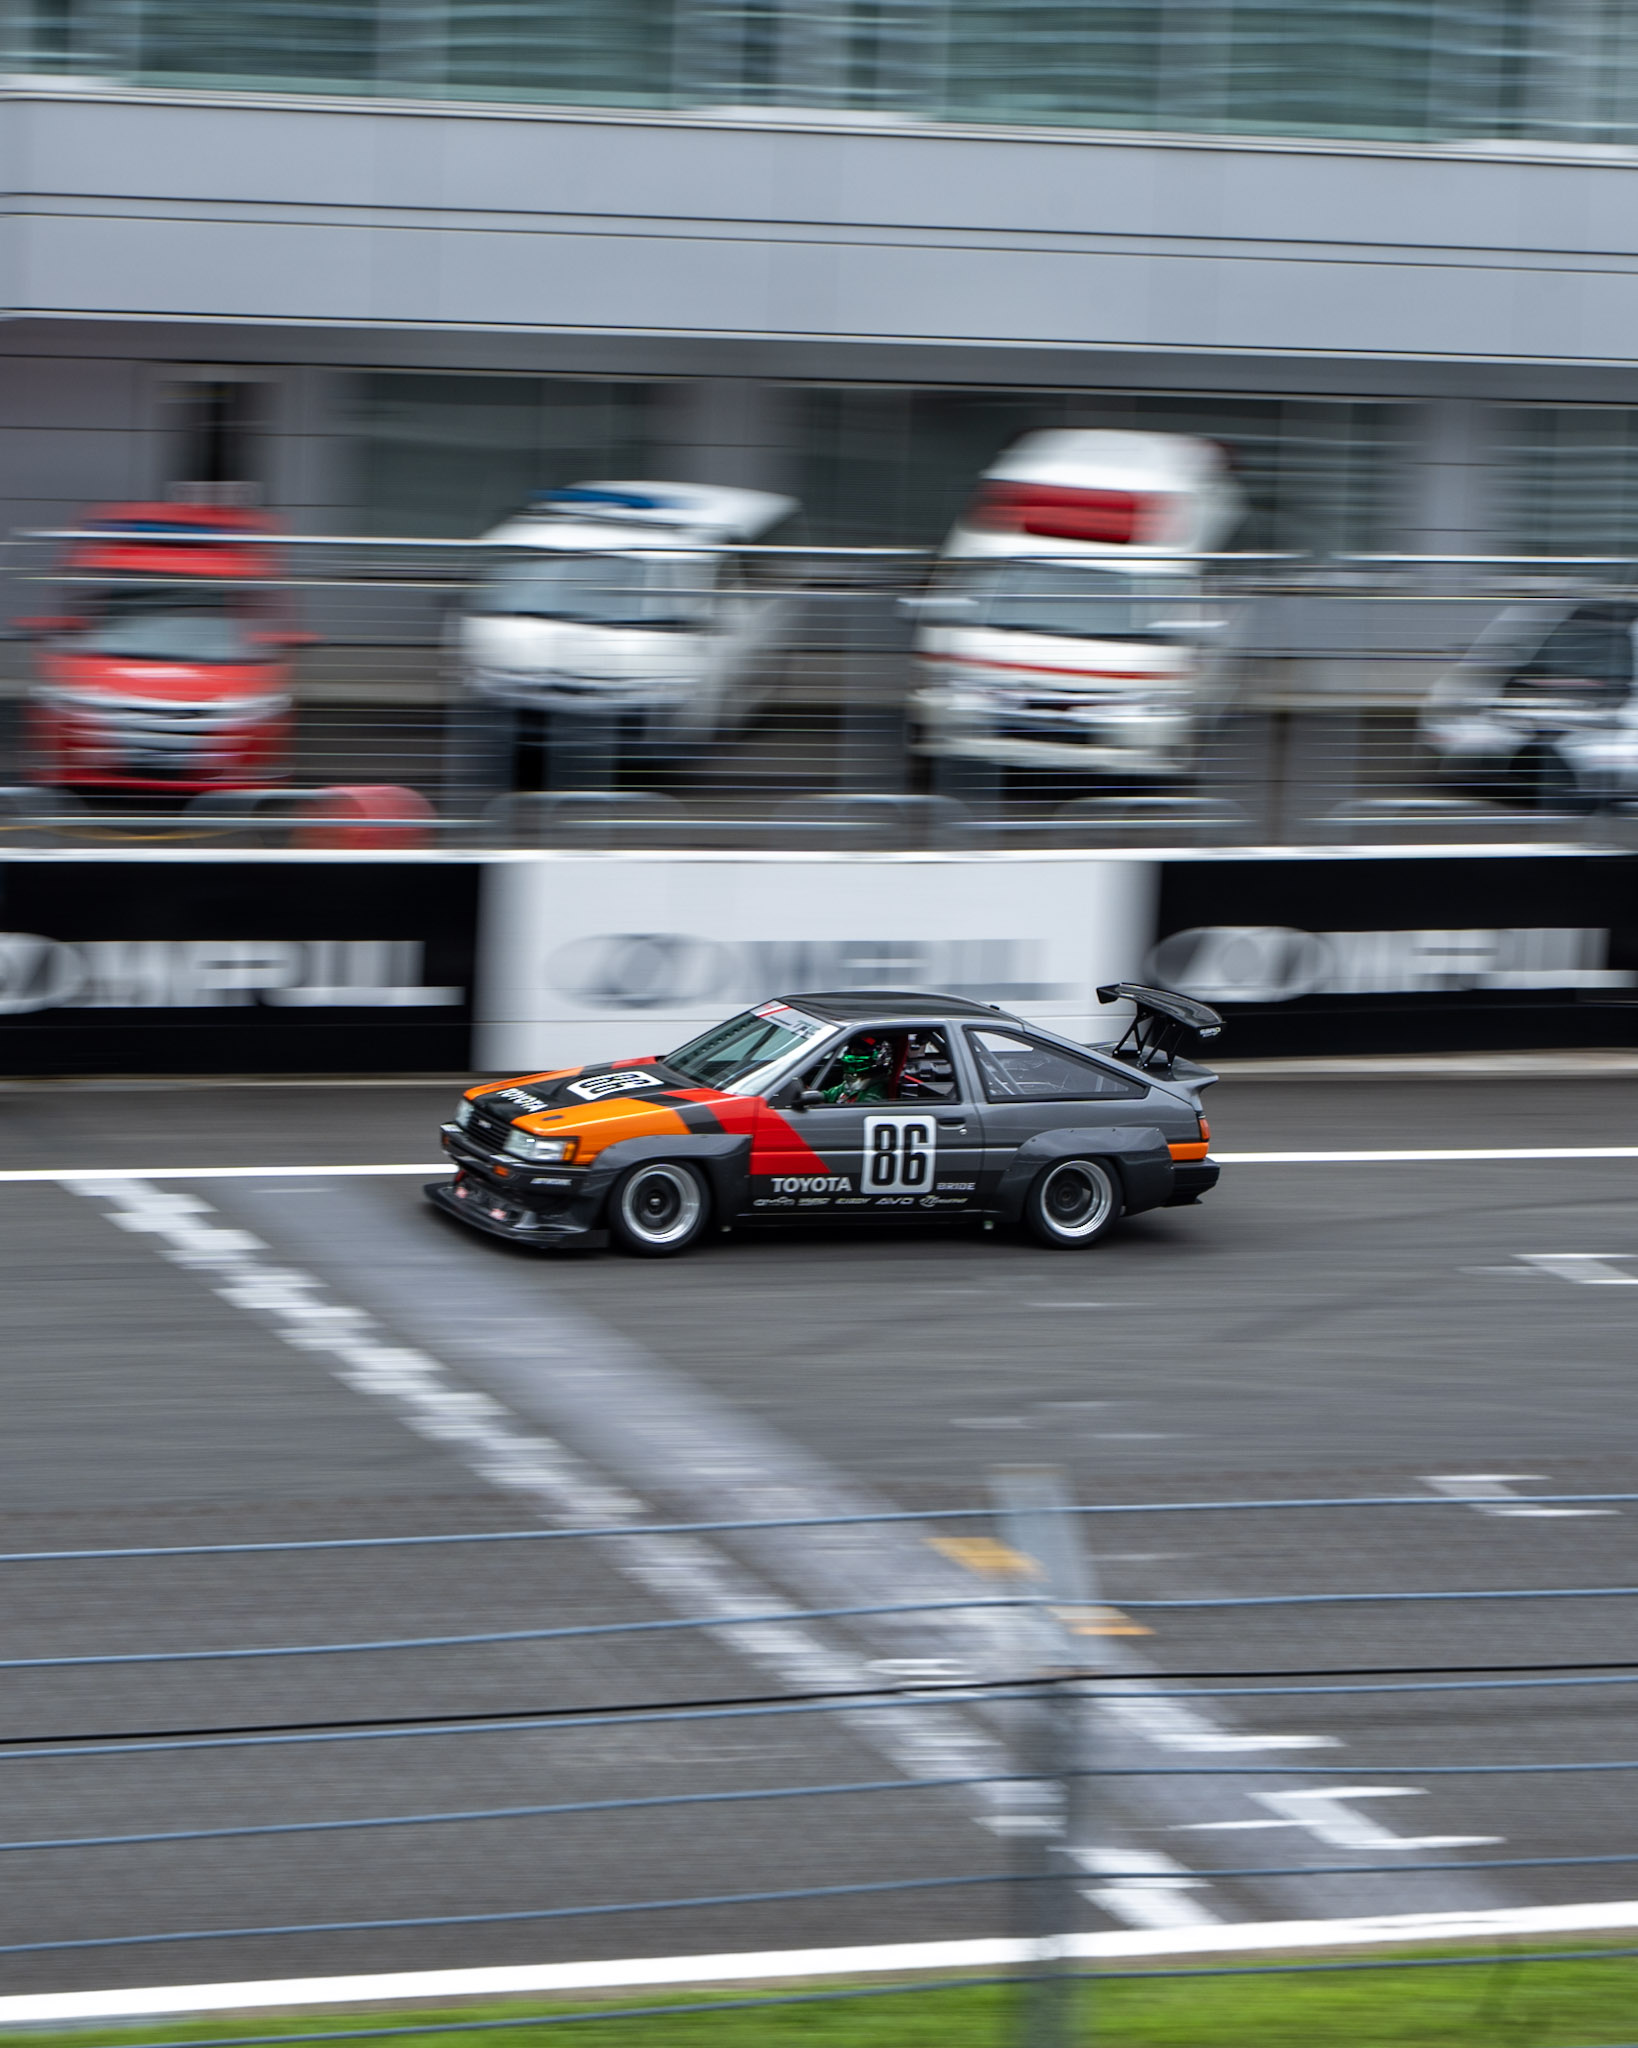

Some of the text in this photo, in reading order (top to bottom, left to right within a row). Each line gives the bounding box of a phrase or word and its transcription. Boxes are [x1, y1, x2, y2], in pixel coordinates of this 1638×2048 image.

[496, 1087, 549, 1113] TOYOTA
[871, 1123, 929, 1186] 86
[771, 1177, 852, 1193] TOYOTA
